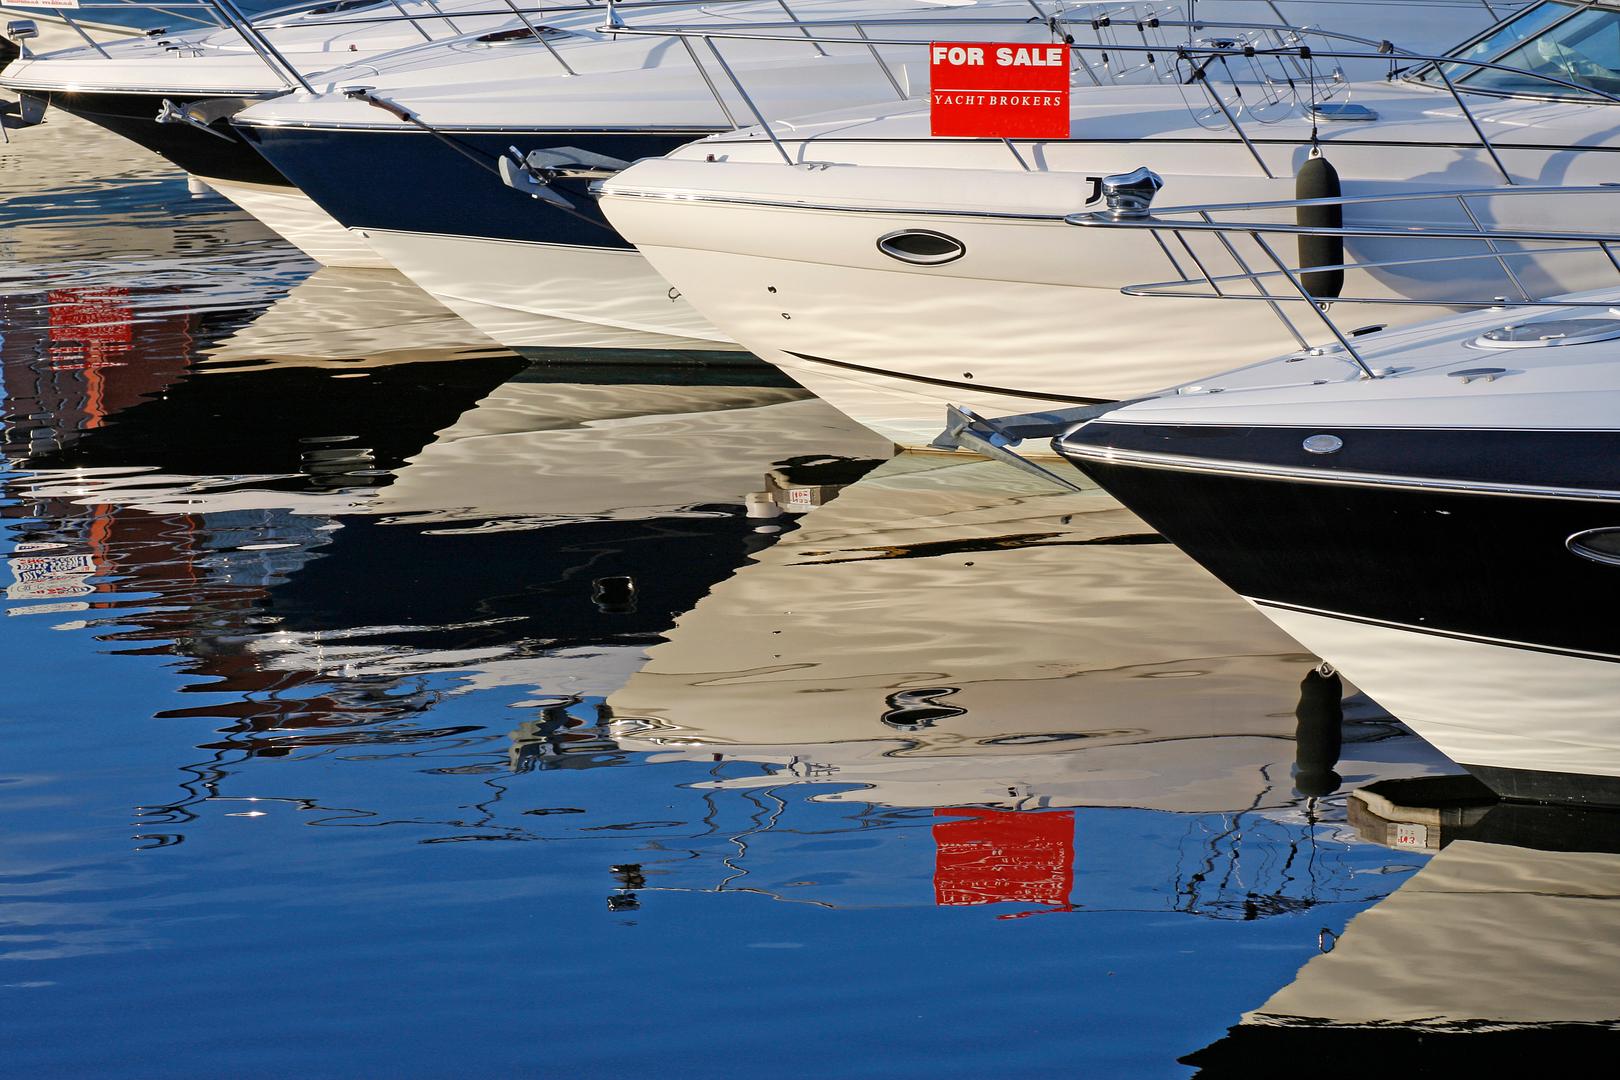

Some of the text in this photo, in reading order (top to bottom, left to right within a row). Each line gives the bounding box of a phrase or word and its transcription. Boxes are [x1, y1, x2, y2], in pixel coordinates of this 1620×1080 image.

[932, 47, 1063, 66] FOR SALE
[934, 95, 1061, 106] YACHT BROKERS
